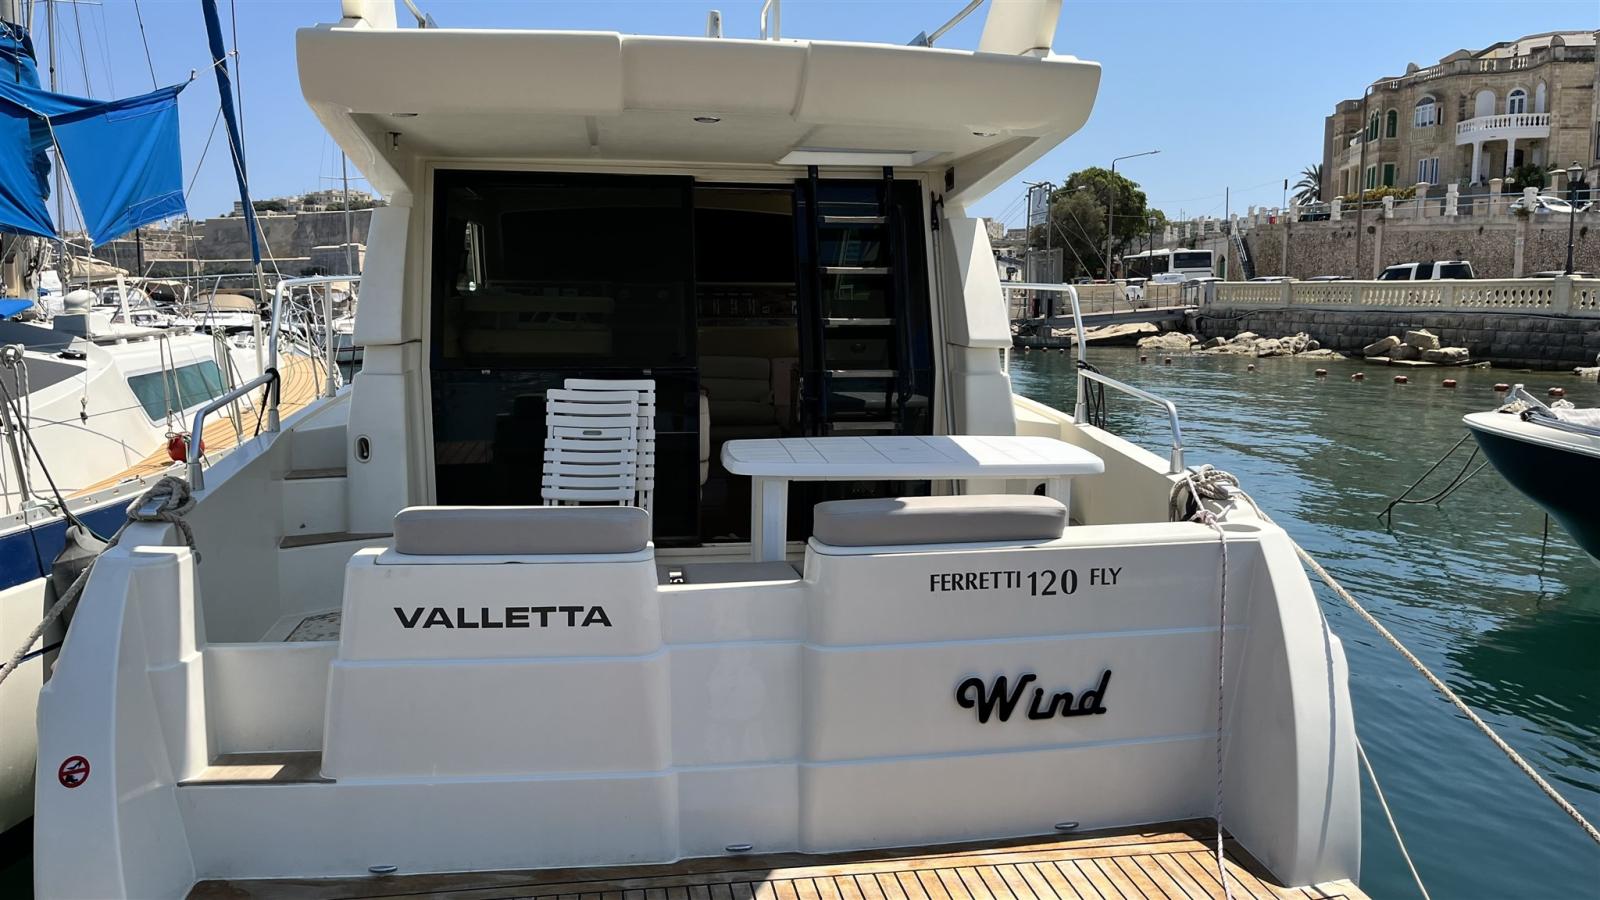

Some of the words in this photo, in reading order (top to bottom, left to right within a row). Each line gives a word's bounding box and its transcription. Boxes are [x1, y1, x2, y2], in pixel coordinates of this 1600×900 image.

[929, 571, 1022, 592] FERRETTI
[1026, 569, 1078, 596] 120
[1089, 567, 1123, 585] FLY
[394, 606, 612, 628] VALLETTA
[954, 669, 1112, 724] Wind
